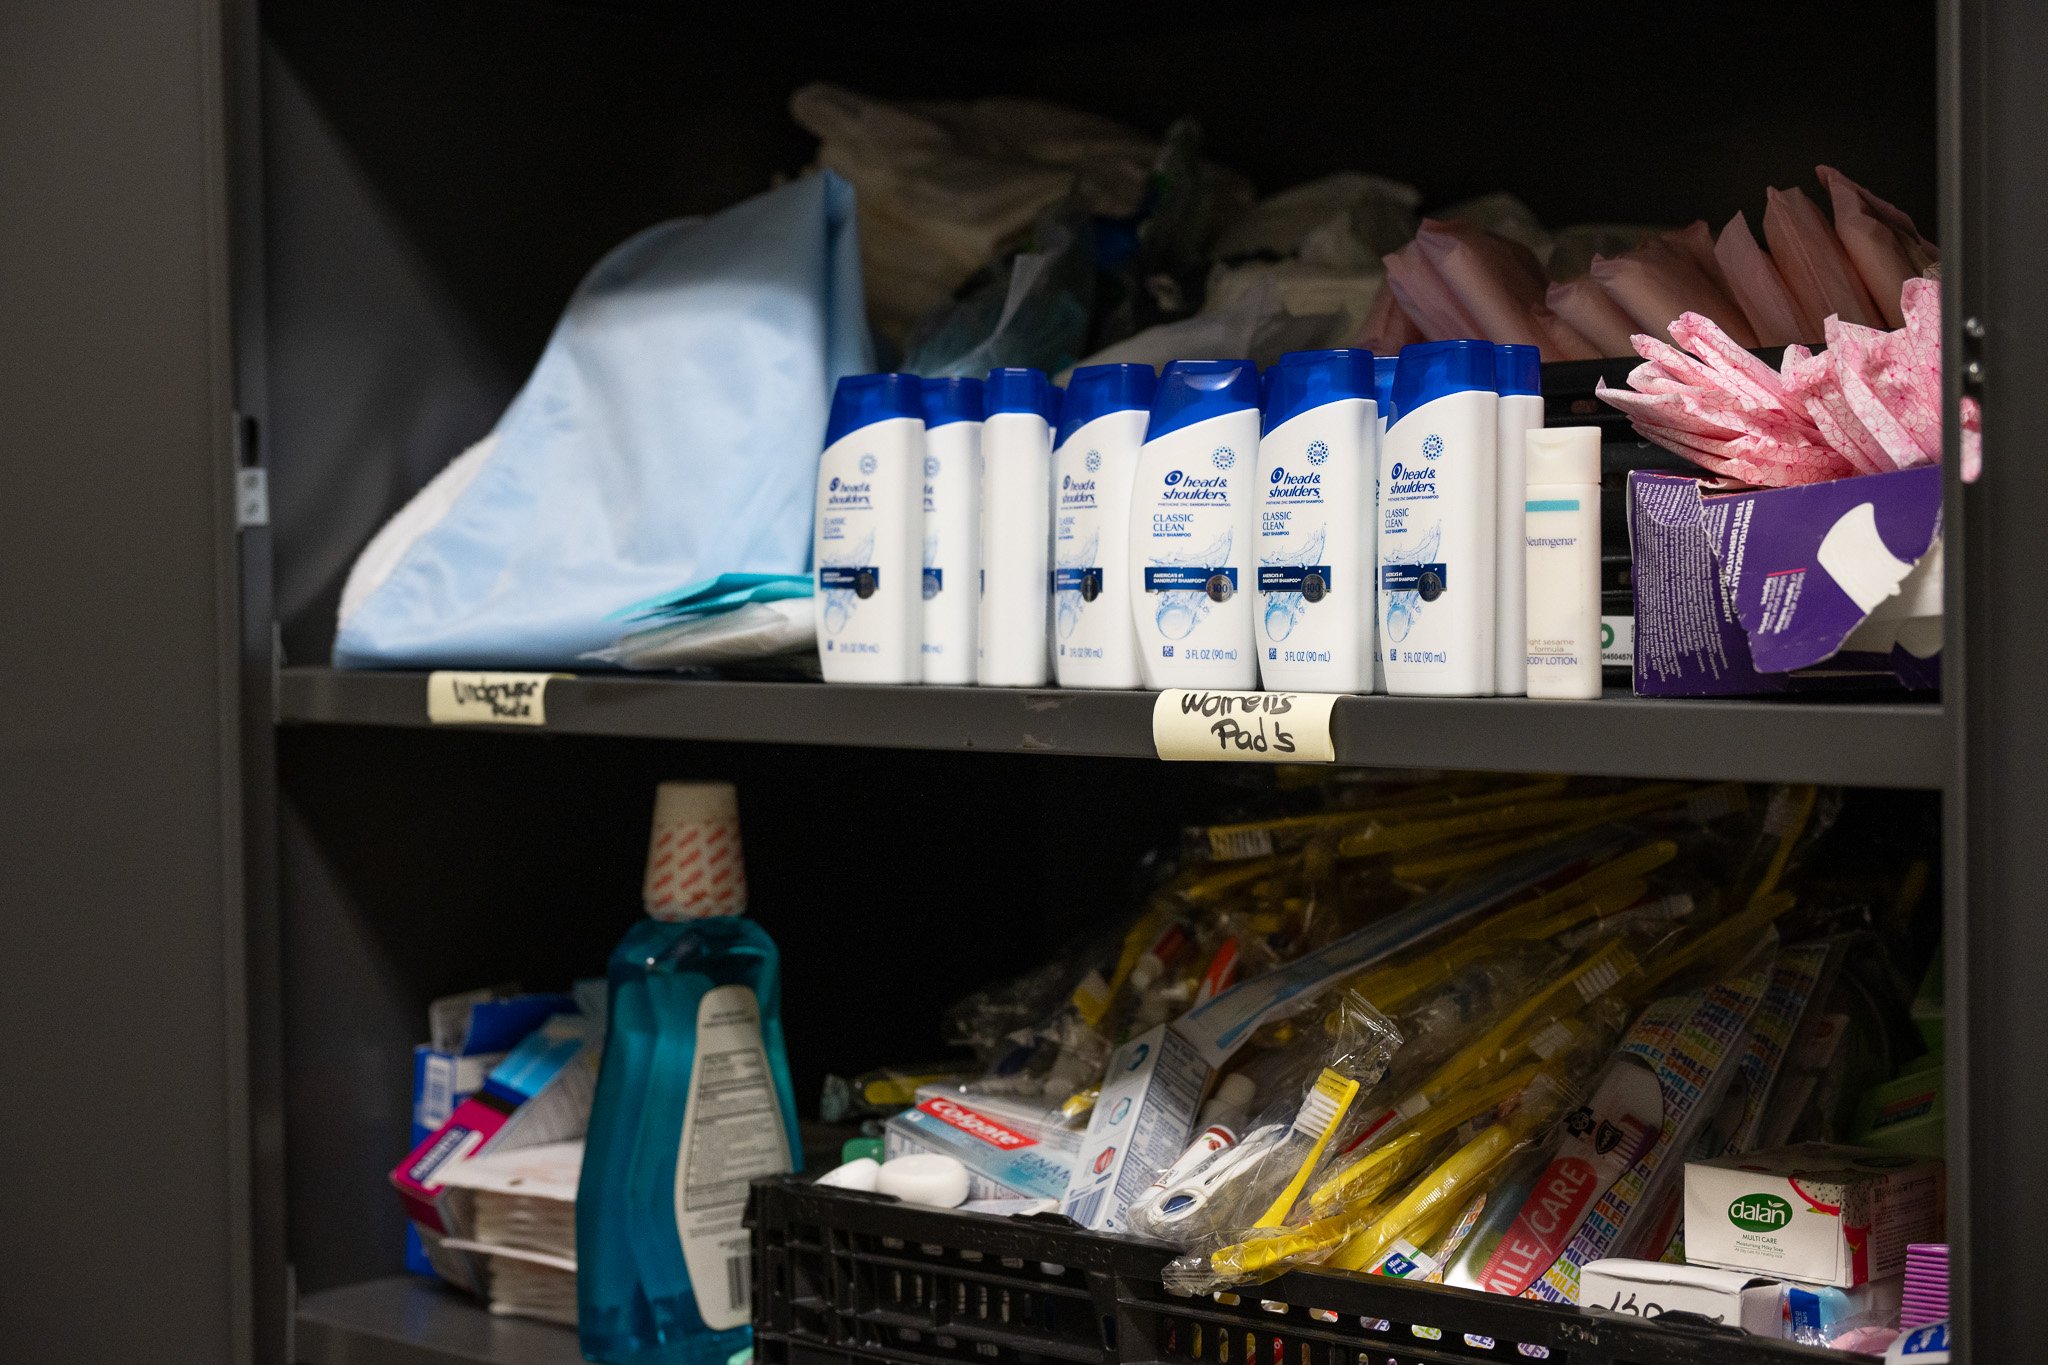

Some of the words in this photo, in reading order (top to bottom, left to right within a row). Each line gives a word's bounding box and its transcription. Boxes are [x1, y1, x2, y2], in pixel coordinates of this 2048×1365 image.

[1284, 472, 1314, 484] head
[1312, 474, 1321, 484] &
[1402, 466, 1429, 480] head
[1428, 468, 1436, 478] &
[1182, 475, 1220, 488] head
[1218, 479, 1228, 488] &
[1390, 480, 1436, 494] shoulders
[1162, 488, 1227, 500] shoulders
[1268, 485, 1320, 498] shoulders
[1153, 514, 1194, 522] CLASSIC
[1262, 512, 1292, 521] CLASSIC
[1385, 508, 1410, 518] CLASSIC
[1733, 501, 1746, 529] TESTÉ
[1153, 523, 1184, 532] CLEAN
[1262, 522, 1284, 530] CLEAN
[1385, 519, 1403, 528] CLEAN
[1731, 499, 1755, 588] DERMATOLOGICALLY
[1213, 584, 1228, 593] 100
[1306, 583, 1321, 593] 100
[1186, 649, 1190, 660] 3
[1192, 649, 1199, 660] FL
[1200, 649, 1210, 660] OZ
[1212, 648, 1224, 660] (90
[1225, 648, 1238, 660] mL)
[1285, 651, 1288, 662] 3
[1290, 652, 1296, 662] FL
[1296, 651, 1305, 662] OZ
[1306, 650, 1317, 662] (90
[1318, 650, 1331, 662] mL)
[1404, 652, 1407, 662] 3
[1408, 652, 1413, 662] FL
[1414, 652, 1422, 662] OZ
[1423, 651, 1432, 663] (90
[1434, 651, 1447, 663] mL)
[1546, 656, 1578, 665] LOTION
[1670, 1047, 1713, 1078] SMILE!
[1665, 1056, 1708, 1087] SMILE!
[1658, 1066, 1700, 1098] SMILE!
[1660, 1079, 1694, 1110] MILE!
[930, 1100, 1020, 1145] Colgate
[1021, 1152, 1070, 1180] ENAM
[1604, 1190, 1632, 1218] ILE!
[1730, 1200, 1786, 1225] dalan
[1590, 1211, 1618, 1237] MILE!
[1581, 1223, 1610, 1253] MILE!
[1742, 1234, 1760, 1242] MULTI
[1761, 1236, 1778, 1244] CARE
[1572, 1236, 1604, 1262] MILE!
[1387, 1258, 1400, 1270] Mint
[1555, 1258, 1580, 1285] MIL
[1543, 1267, 1581, 1299] MILE!
[1530, 1278, 1577, 1306] SMILE
